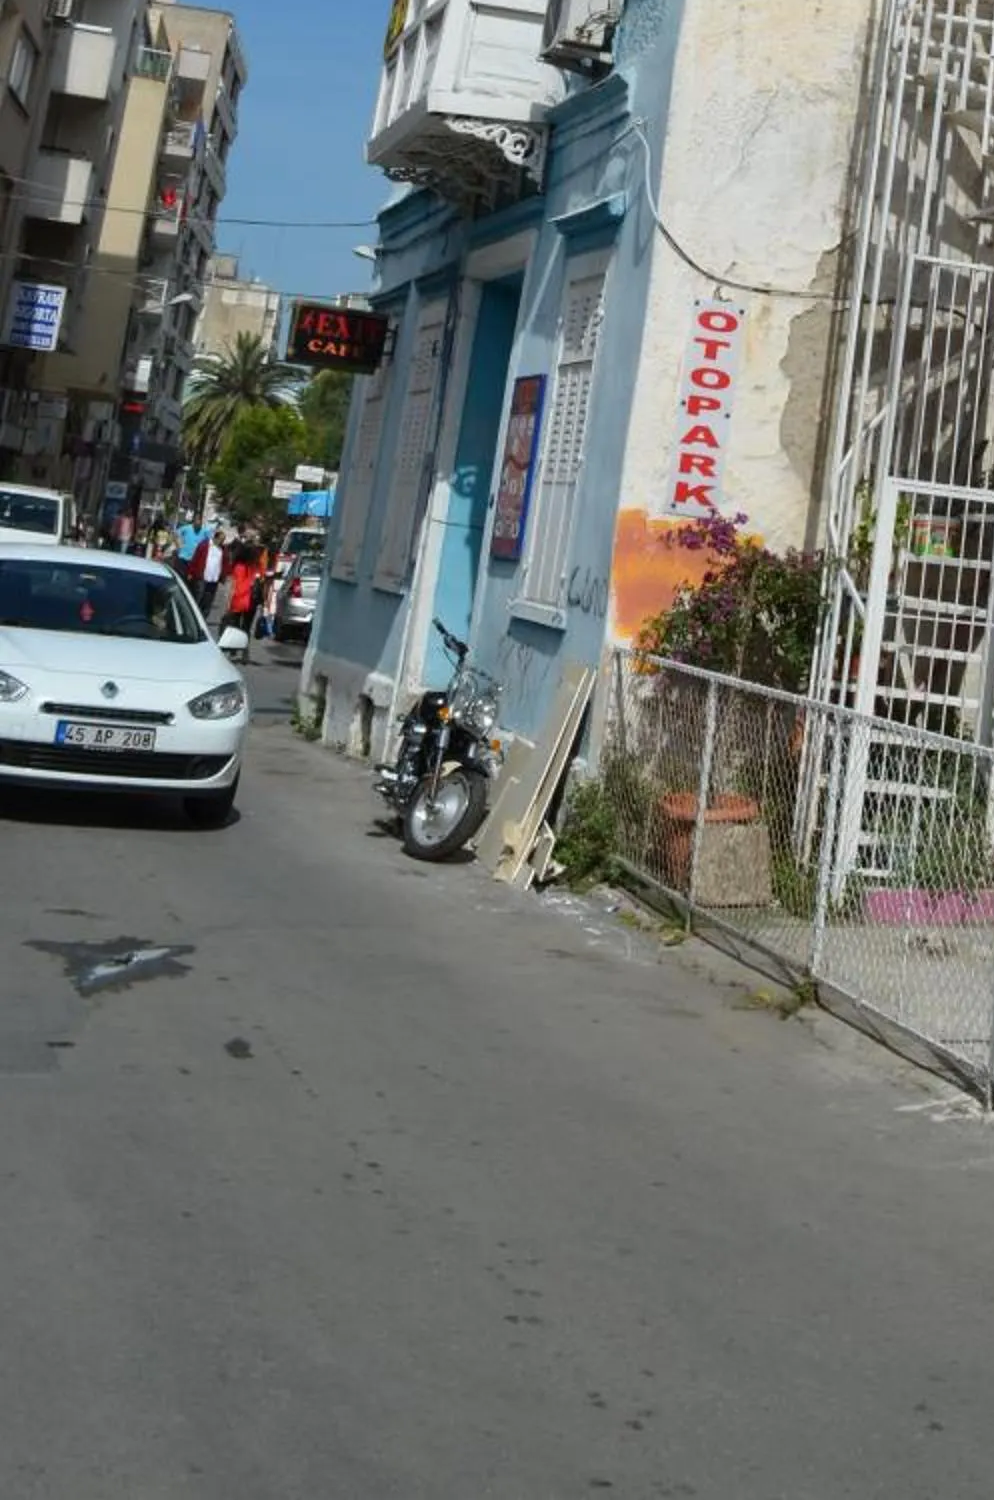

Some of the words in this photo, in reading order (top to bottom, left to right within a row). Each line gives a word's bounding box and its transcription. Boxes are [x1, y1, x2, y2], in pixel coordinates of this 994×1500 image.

[673, 311, 738, 507] OTOPARK
[64, 724, 85, 742] 45
[94, 729, 114, 744] AP
